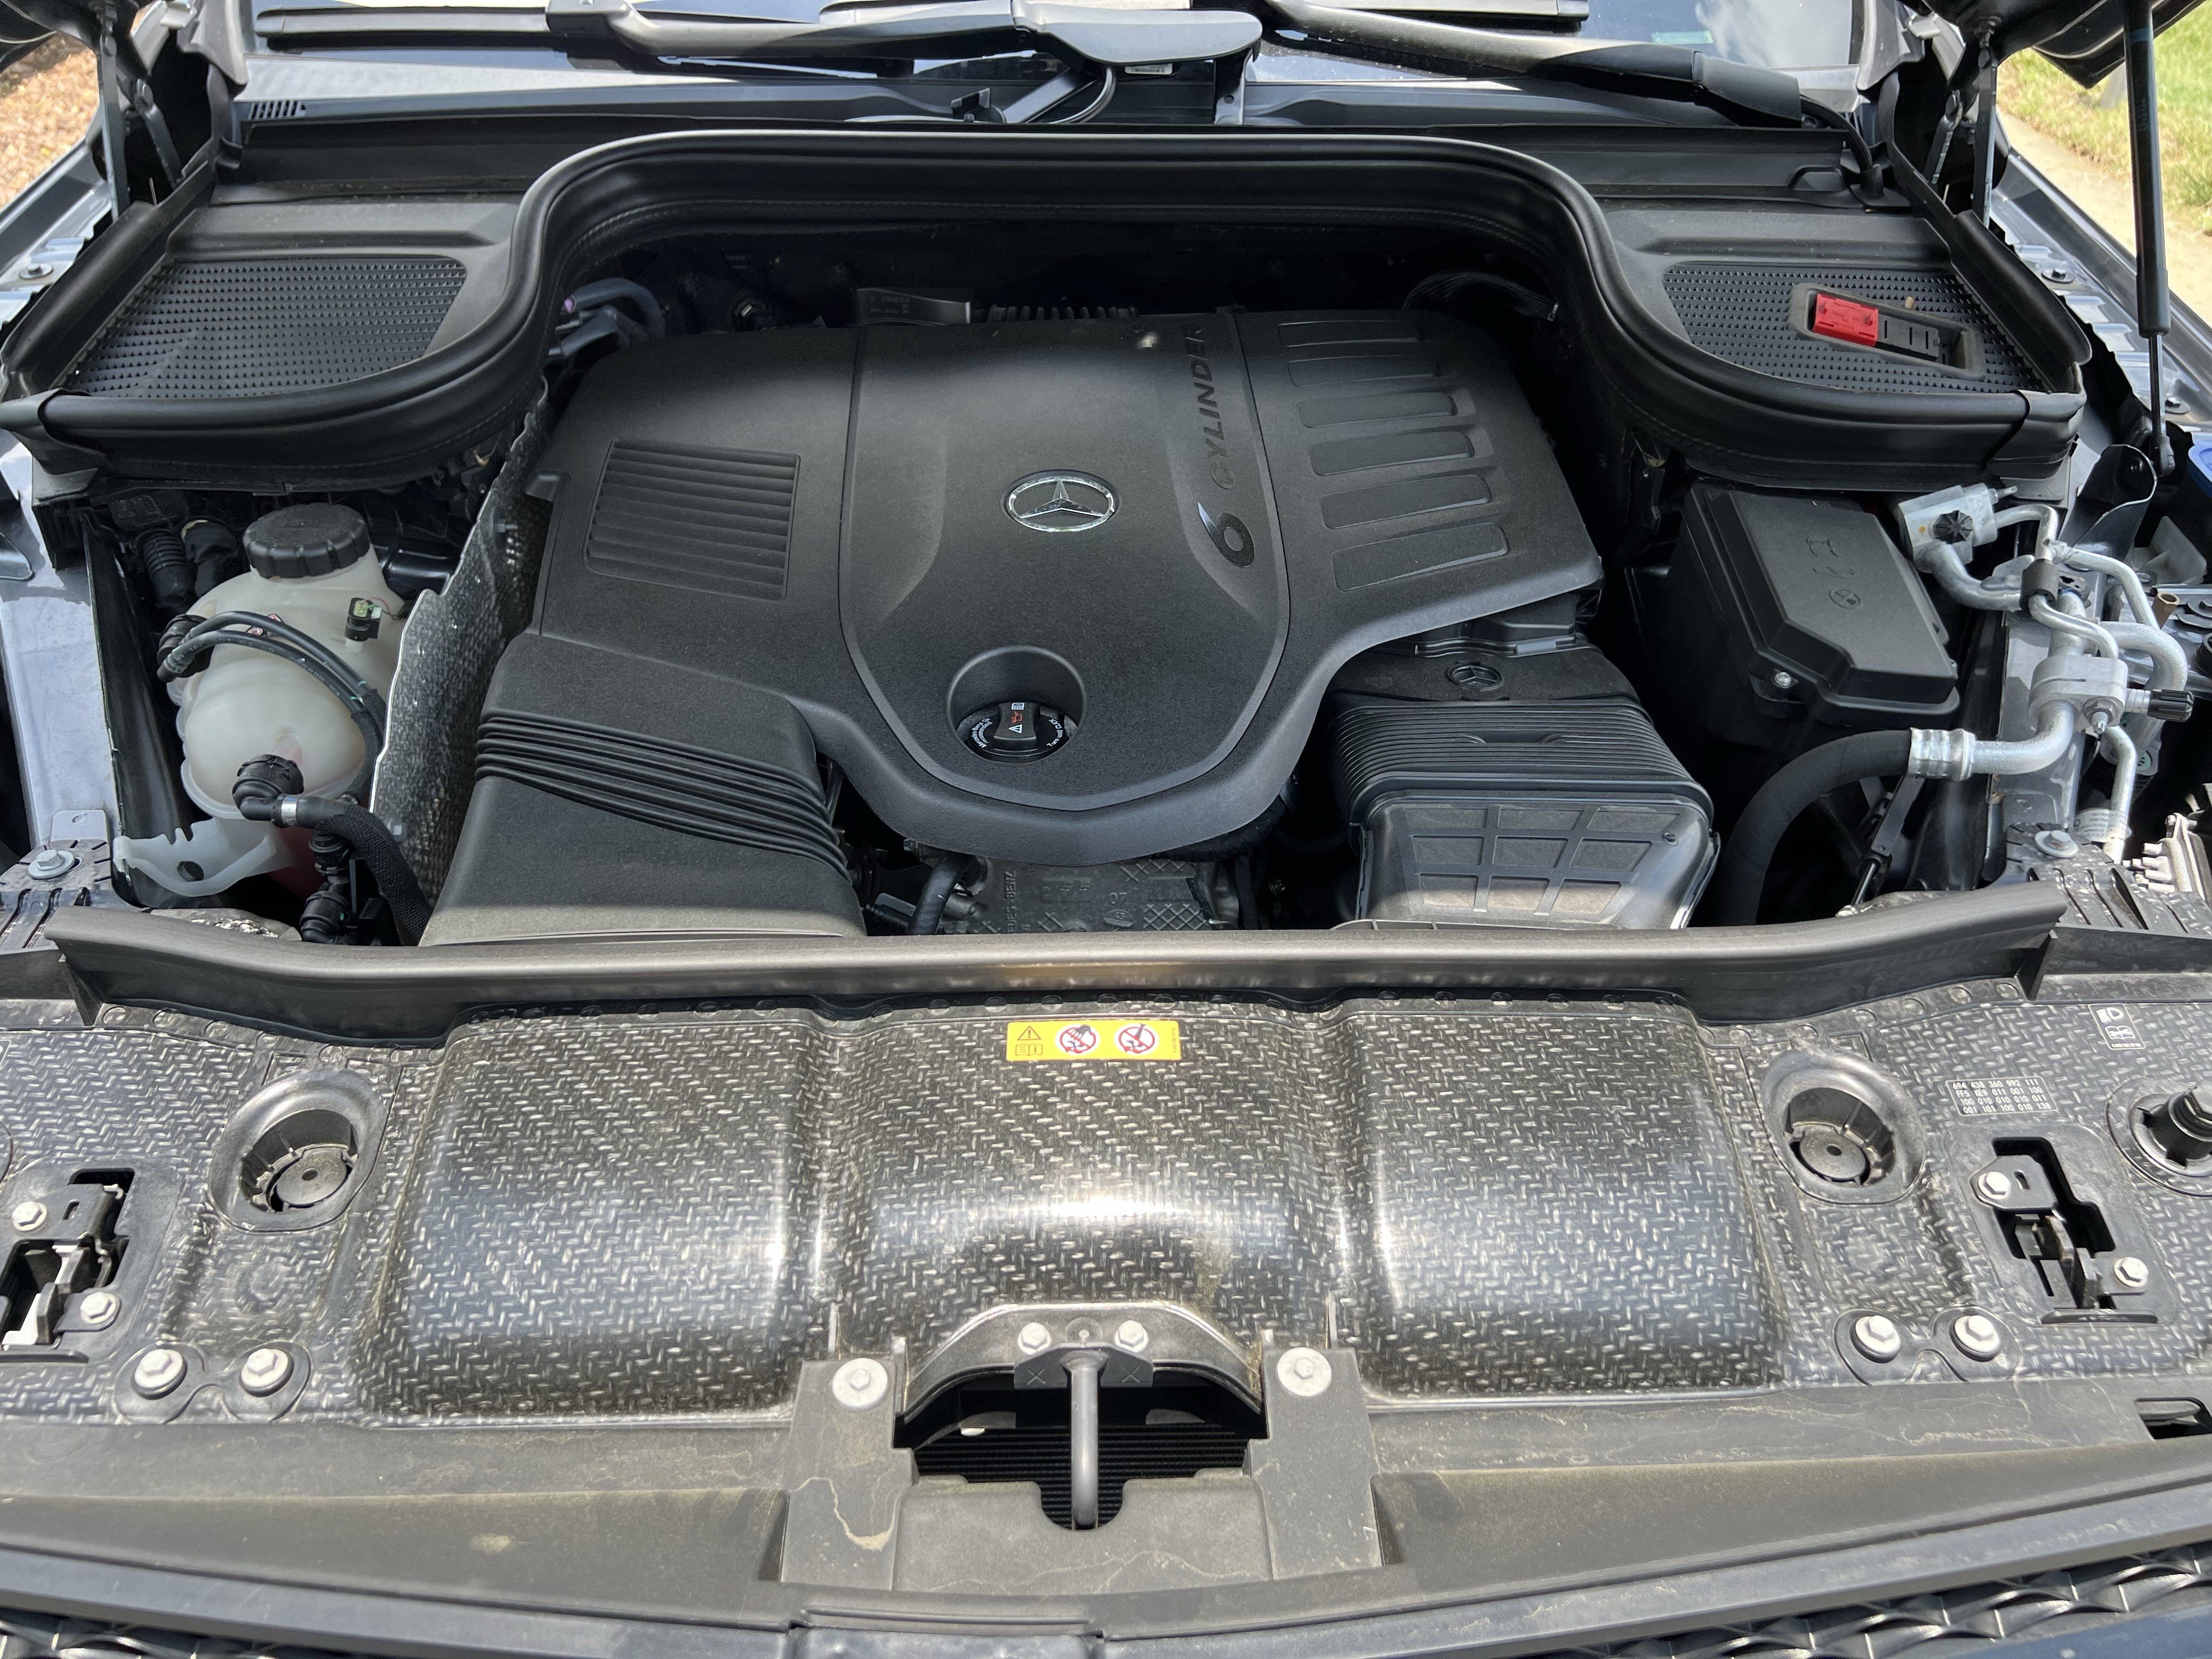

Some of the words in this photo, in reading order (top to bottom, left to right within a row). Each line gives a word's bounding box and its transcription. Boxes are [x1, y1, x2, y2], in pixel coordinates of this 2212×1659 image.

[1197, 501, 1255, 568] 6
[1046, 738, 1060, 747] Turn
[2006, 1079, 2022, 1087] 992
[1995, 1096, 2011, 1104] 010
[2000, 1104, 2016, 1112] 100
